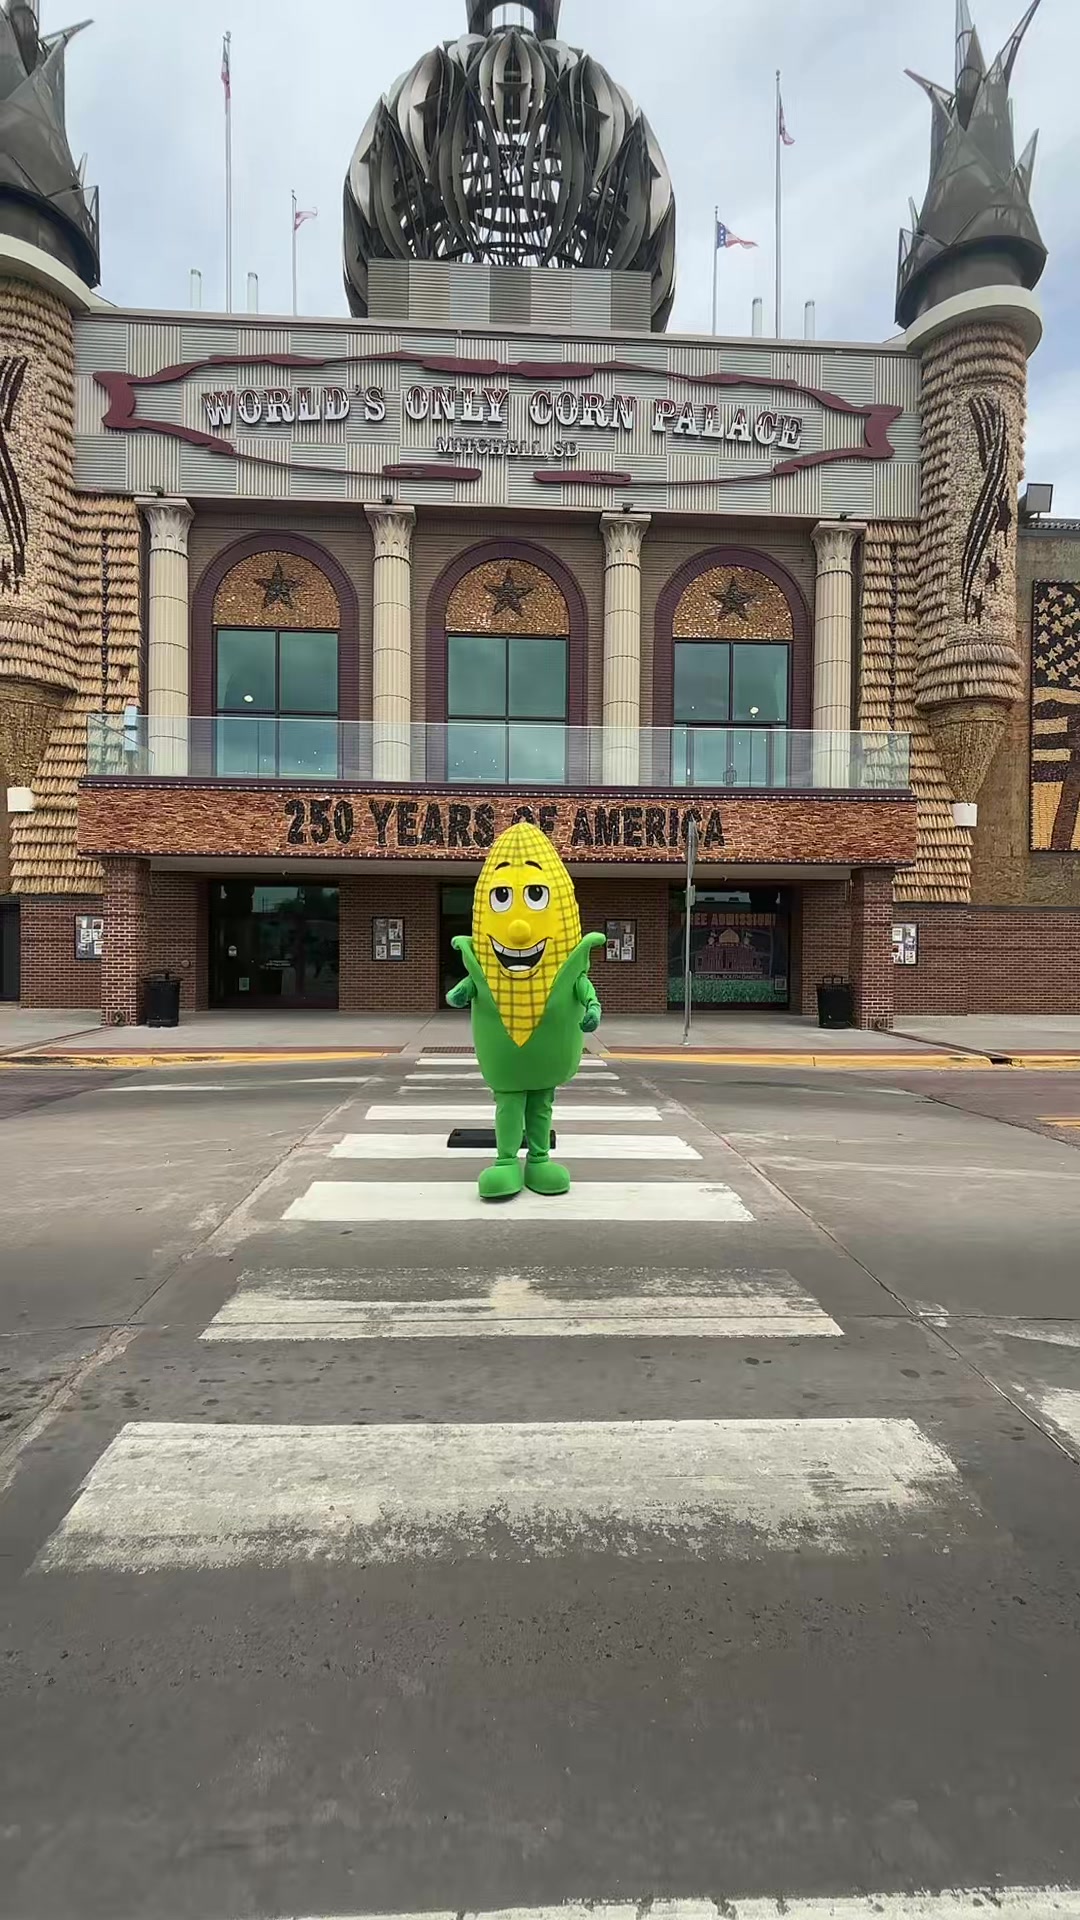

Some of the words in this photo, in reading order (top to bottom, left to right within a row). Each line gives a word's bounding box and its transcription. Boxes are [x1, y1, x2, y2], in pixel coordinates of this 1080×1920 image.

[201, 384, 387, 427] WORLD'S
[404, 384, 510, 424] ONLY
[529, 390, 637, 430] CORN
[652, 398, 803, 450] PALACE
[436, 435, 549, 460] MITCHELL,
[552, 440, 580, 458] SD
[284, 799, 354, 845] 250
[367, 801, 496, 848] YEARS
[570, 806, 726, 848] AMERICA
